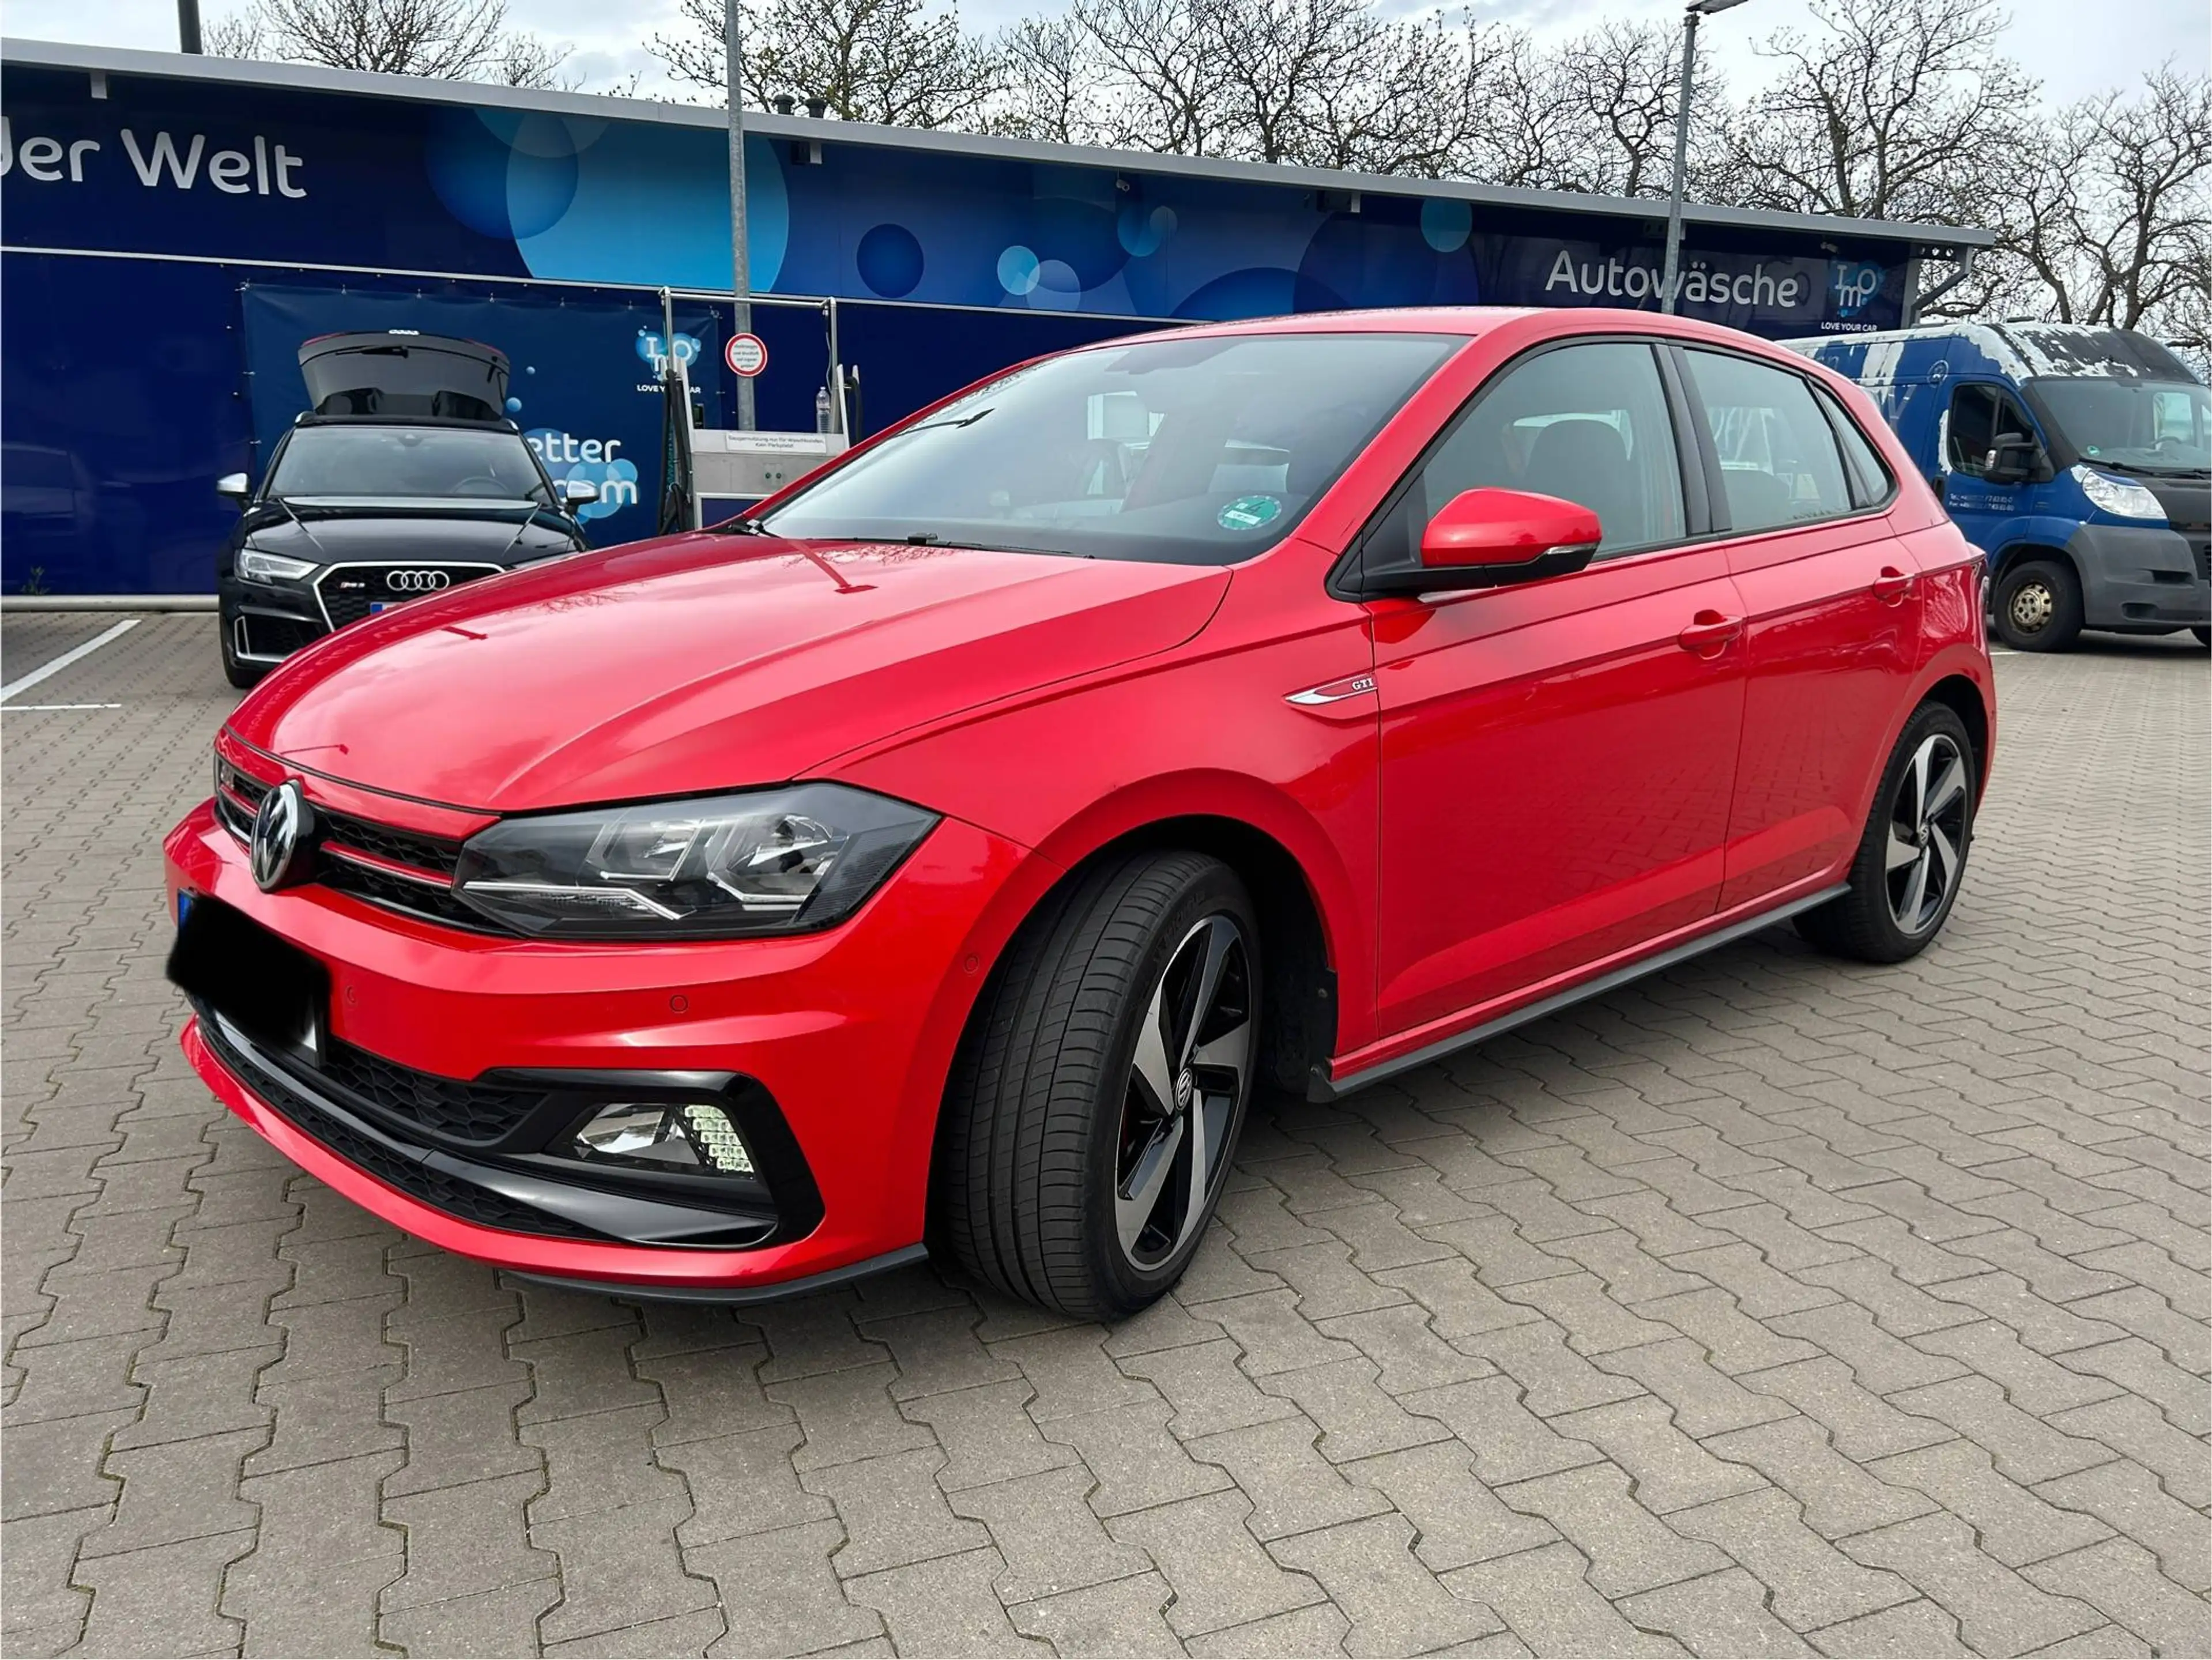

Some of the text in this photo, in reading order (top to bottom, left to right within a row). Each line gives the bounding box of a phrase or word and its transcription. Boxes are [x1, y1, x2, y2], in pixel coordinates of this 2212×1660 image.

[120, 129, 308, 198] Welt
[1545, 250, 1799, 307] Autowäsche
[1821, 322, 1878, 332] LOVE YOUR CAR
[636, 384, 659, 392] LOVE
[526, 432, 621, 463] etter
[1351, 677, 1374, 691] GTI
